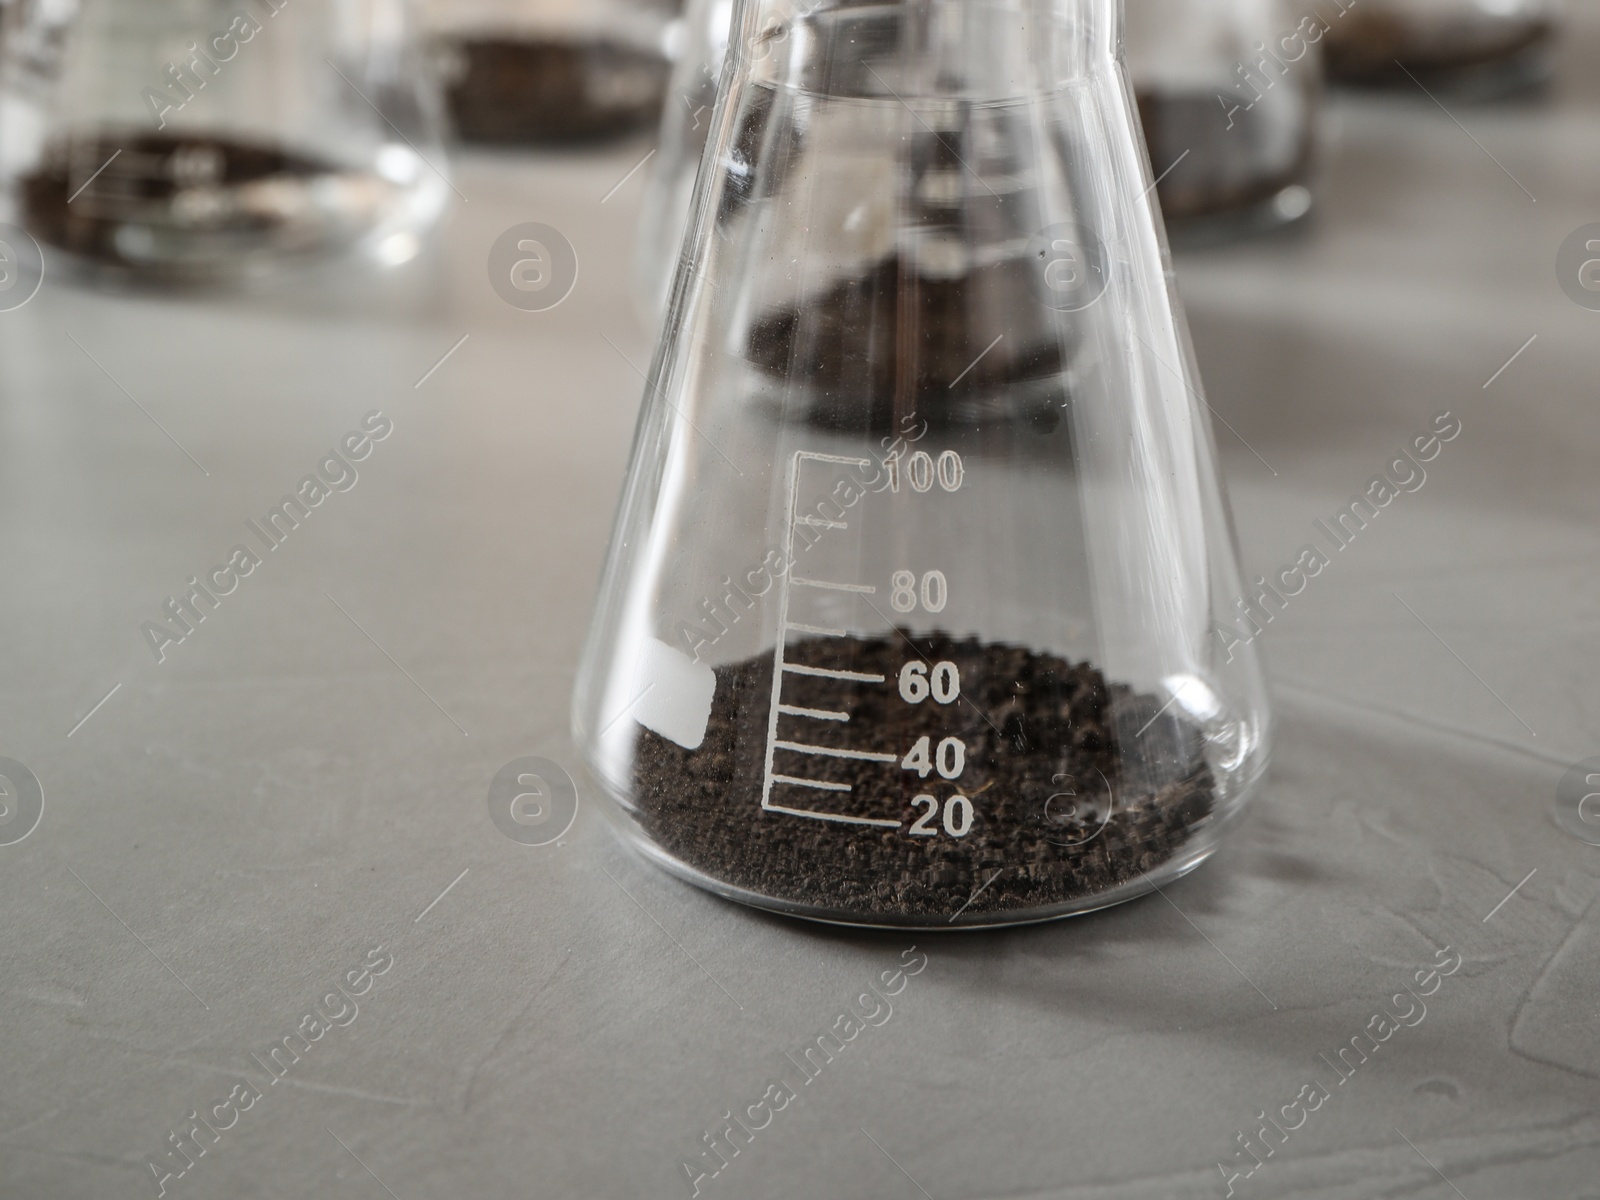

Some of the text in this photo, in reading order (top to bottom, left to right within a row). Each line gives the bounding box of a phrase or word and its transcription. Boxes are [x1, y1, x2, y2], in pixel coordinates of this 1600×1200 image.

[883, 450, 965, 492] 100
[891, 570, 947, 612] 80
[898, 660, 960, 704] 60
[901, 736, 966, 779] 40
[909, 794, 974, 837] 20
